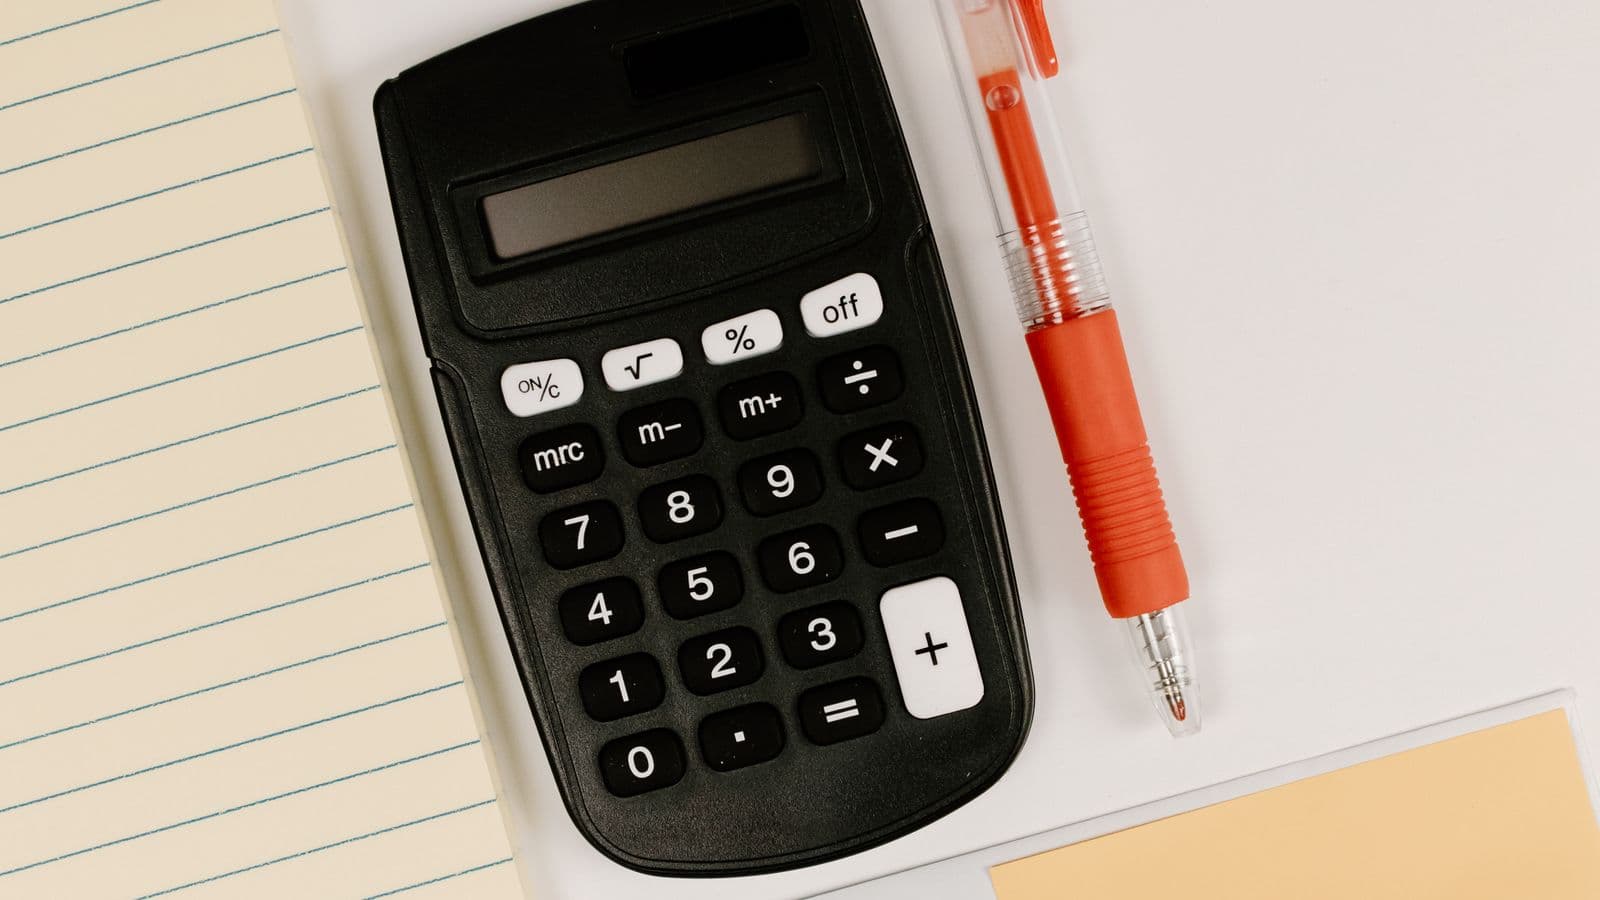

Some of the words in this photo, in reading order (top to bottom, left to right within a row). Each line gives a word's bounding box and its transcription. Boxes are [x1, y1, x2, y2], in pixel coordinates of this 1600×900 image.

[822, 293, 860, 324] off
[725, 325, 756, 353] %
[738, 393, 783, 419] m+
[533, 441, 585, 472] mrc
[766, 464, 798, 498] 9
[667, 490, 695, 524] 8
[564, 514, 590, 550] 7
[788, 541, 816, 575] 6
[687, 566, 714, 601] 5
[587, 592, 613, 625] 4
[807, 617, 837, 651] 3
[914, 630, 949, 667] +
[706, 643, 737, 679] 2
[609, 669, 631, 703] 1
[823, 697, 860, 723] =
[627, 745, 655, 779] 0
